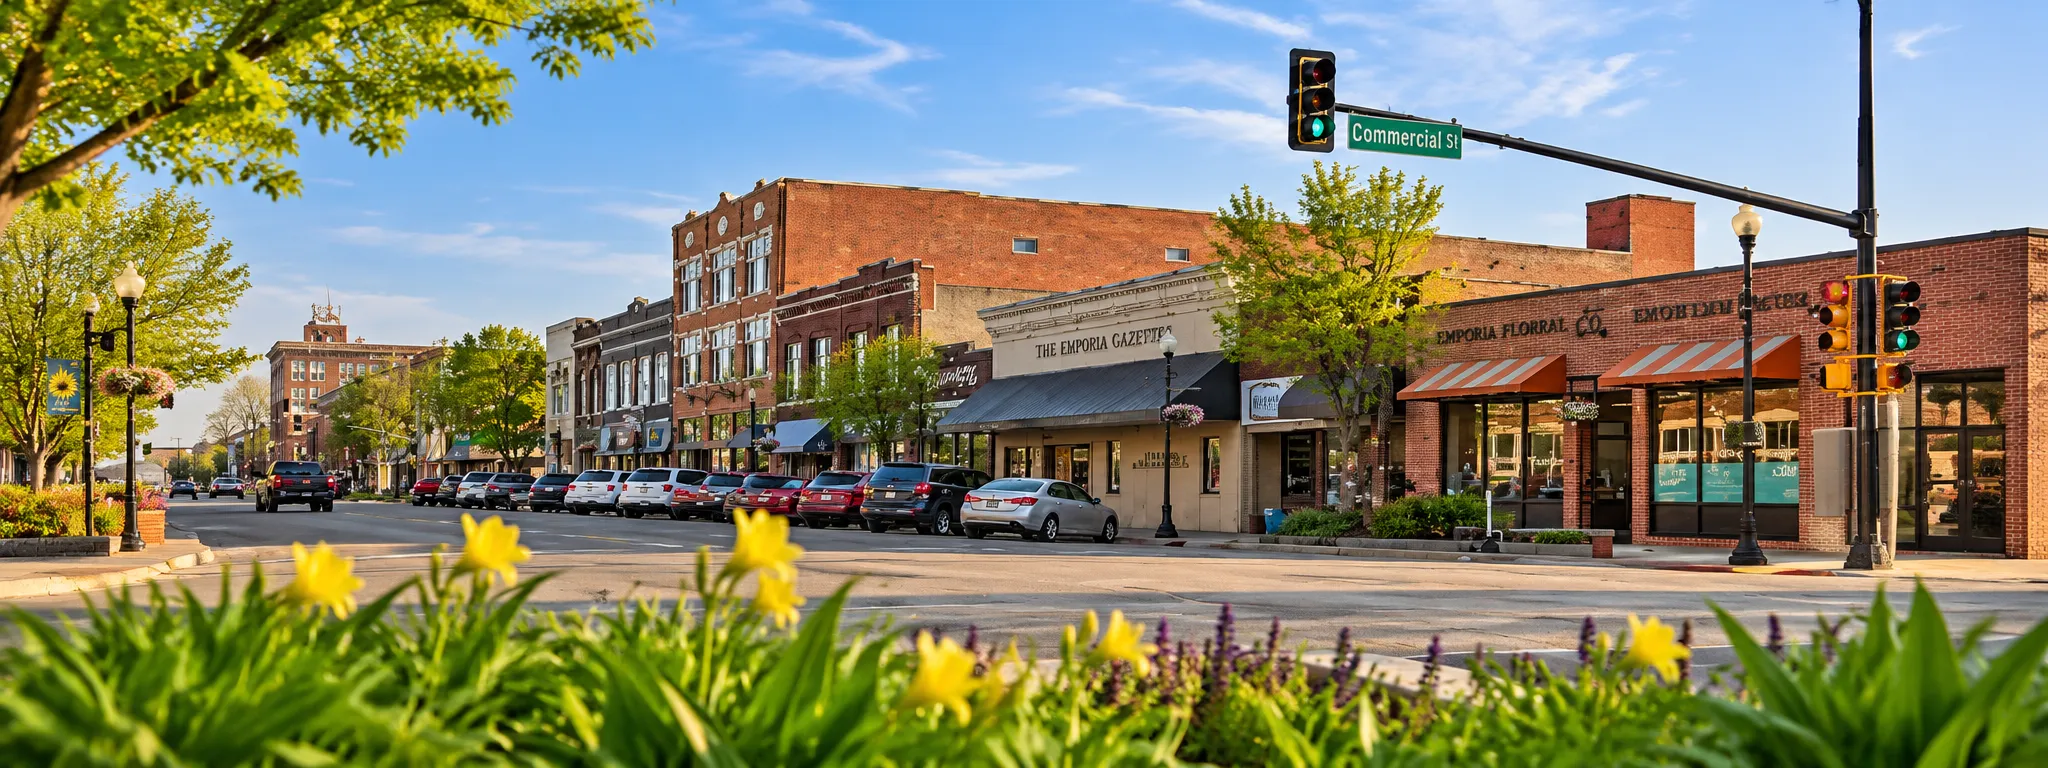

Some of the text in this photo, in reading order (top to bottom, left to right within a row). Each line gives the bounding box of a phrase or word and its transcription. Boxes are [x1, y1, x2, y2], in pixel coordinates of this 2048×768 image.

[1352, 123, 1458, 149] Commercial St
[1436, 325, 1497, 345] EMPORIA
[1502, 316, 1568, 338] FLORRAL
[1035, 342, 1056, 358] THE
[1060, 335, 1108, 356] EMPORIA
